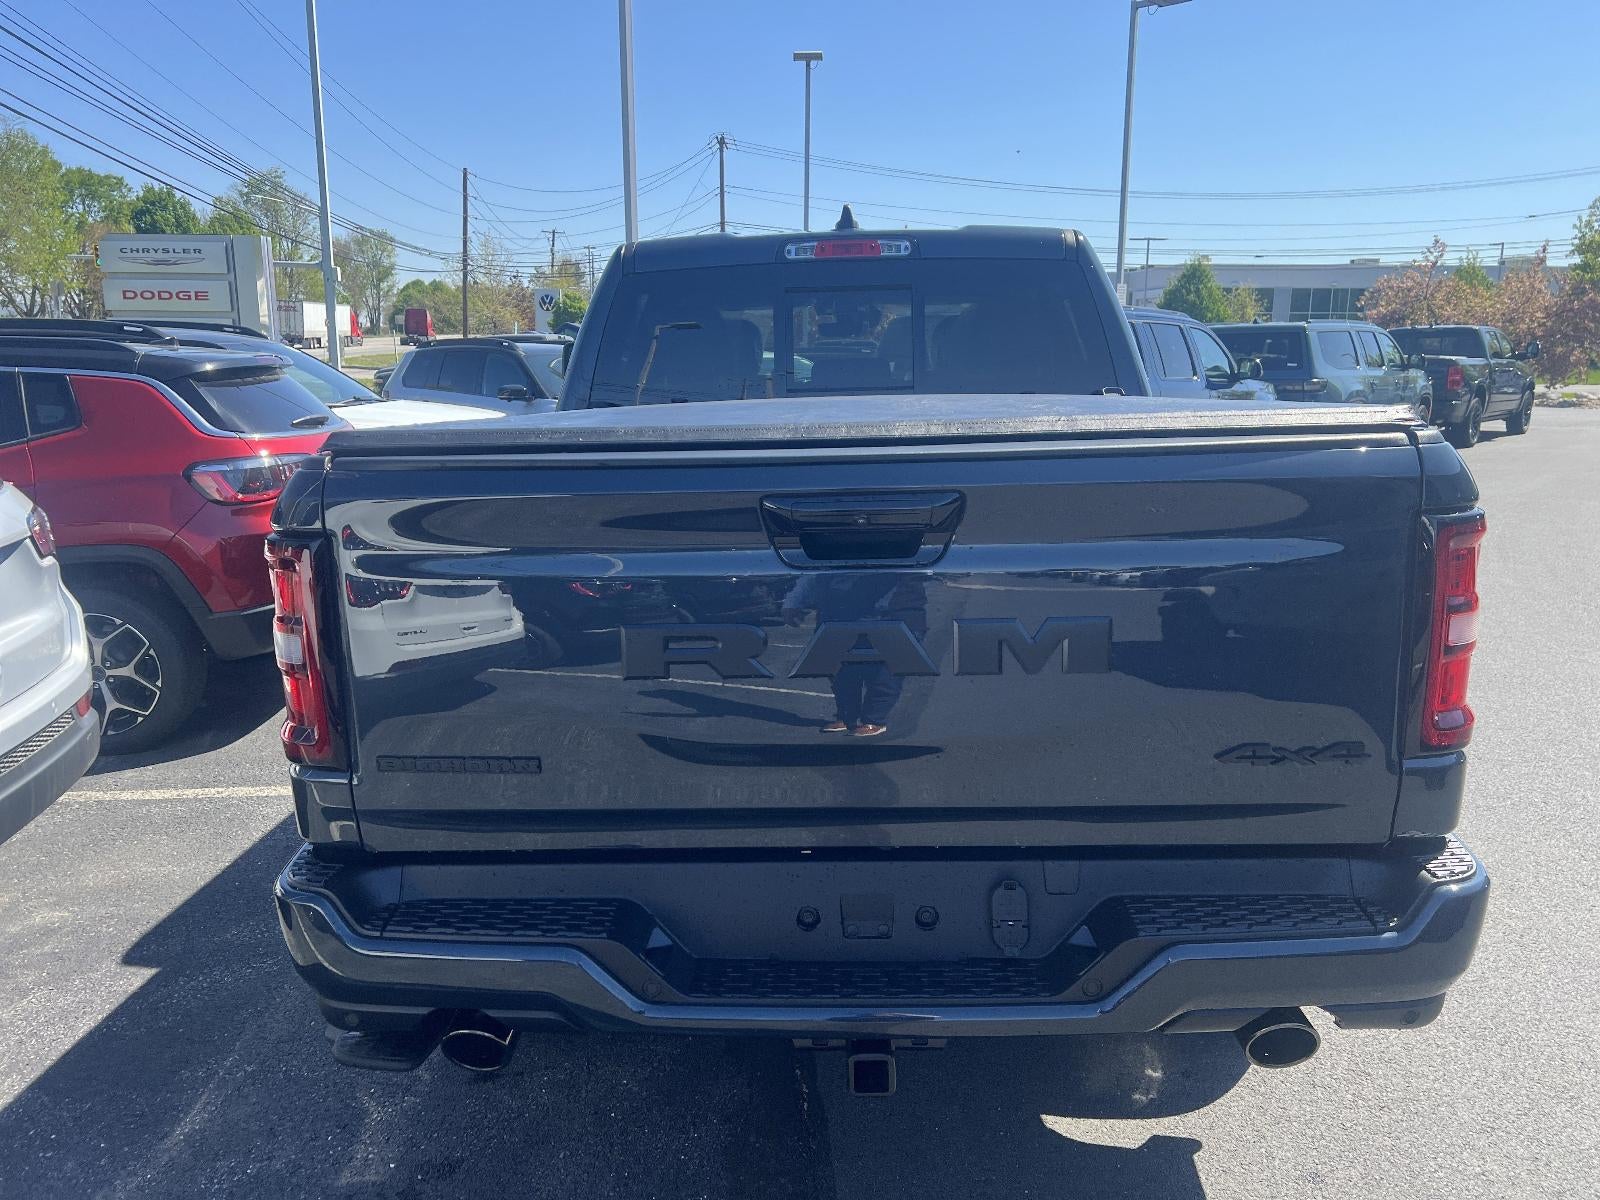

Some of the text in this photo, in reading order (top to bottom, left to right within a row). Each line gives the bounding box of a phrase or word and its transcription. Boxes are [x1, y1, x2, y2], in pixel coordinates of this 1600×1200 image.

[119, 247, 203, 255] CHRYSLER
[121, 289, 210, 301] DODGE
[619, 616, 1113, 680] RAM
